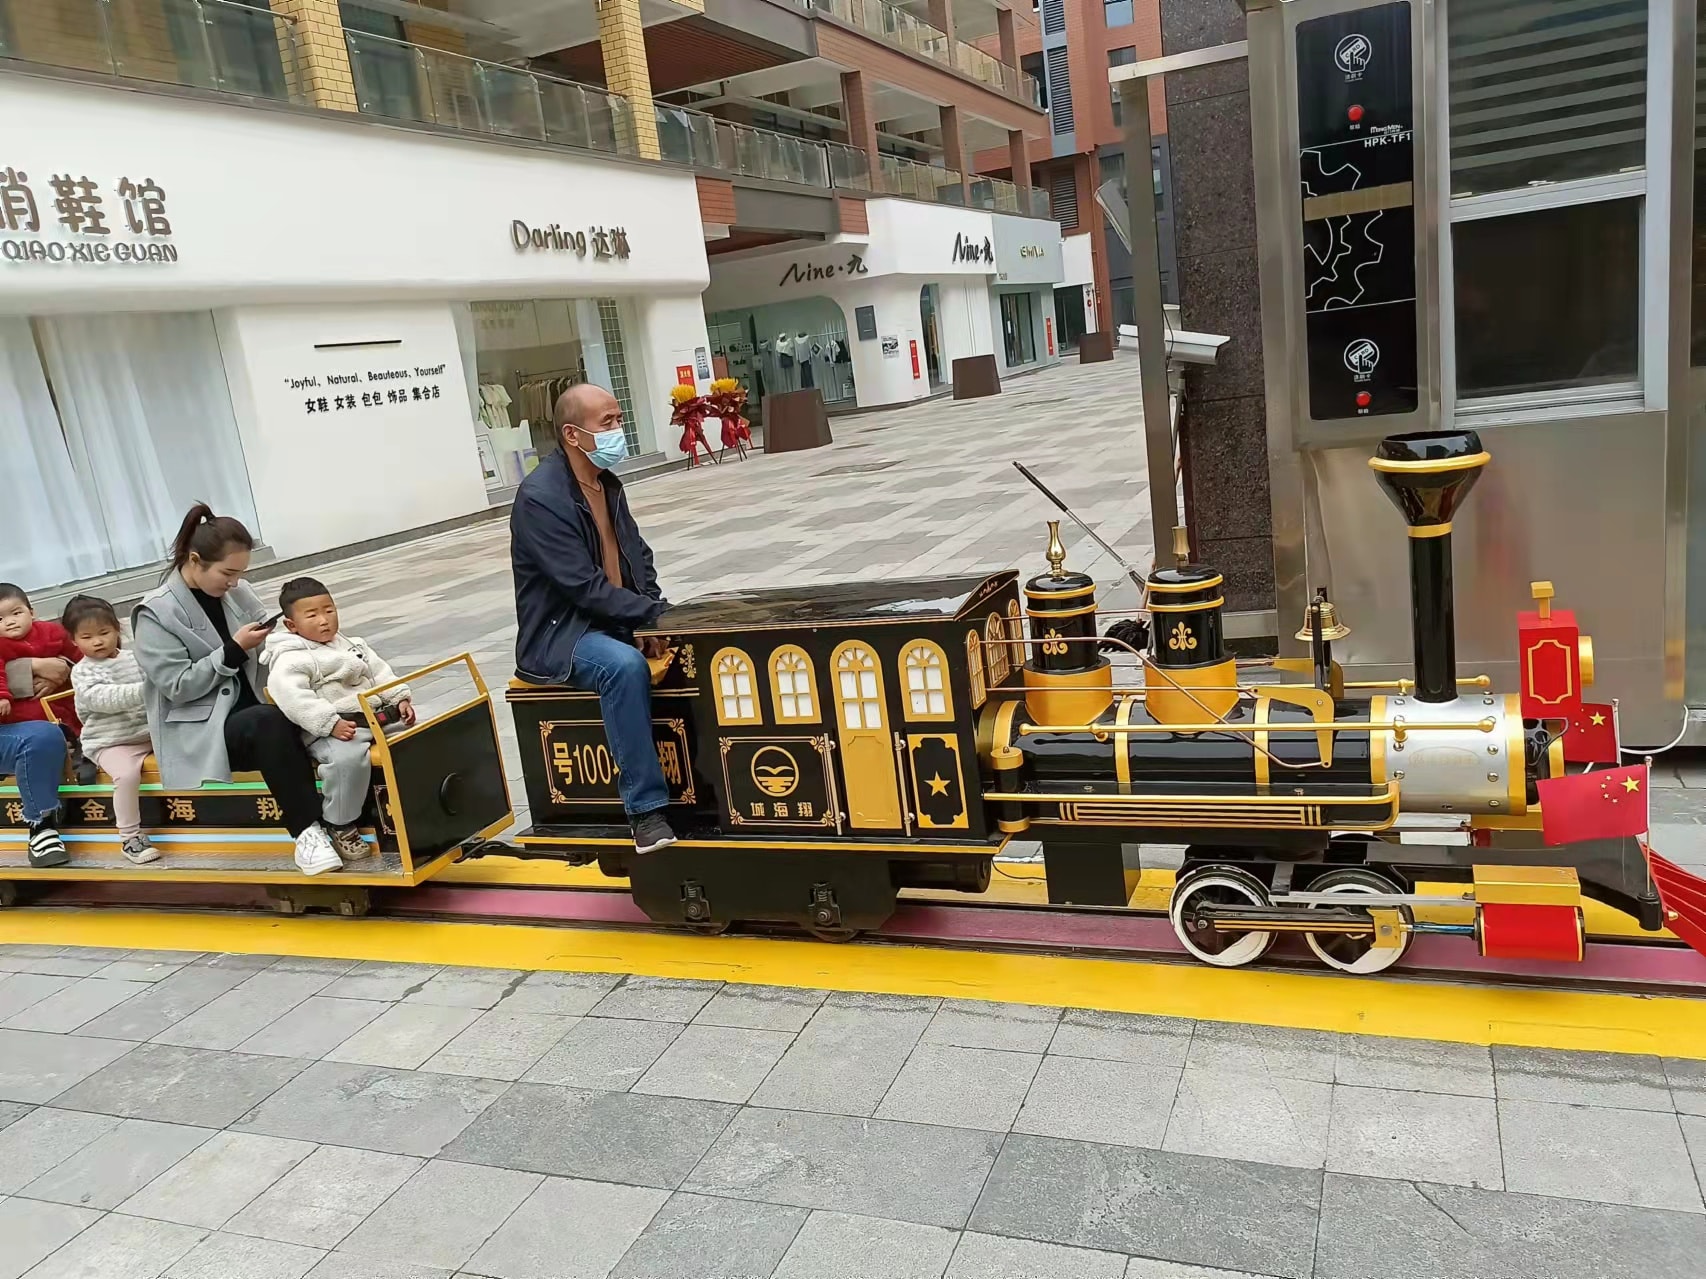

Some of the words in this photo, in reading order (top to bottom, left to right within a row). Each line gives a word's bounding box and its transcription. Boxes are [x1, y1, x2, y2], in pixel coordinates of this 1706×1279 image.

[1364, 132, 1411, 148] HPK-TF1
[511, 219, 587, 257] Darling
[113, 242, 178, 262] GUAN
[305, 396, 330, 414] 女鞋
[334, 394, 357, 410] 女装
[361, 391, 383, 407] 包包
[387, 389, 408, 404] 饰品
[412, 384, 441, 401] 集合店
